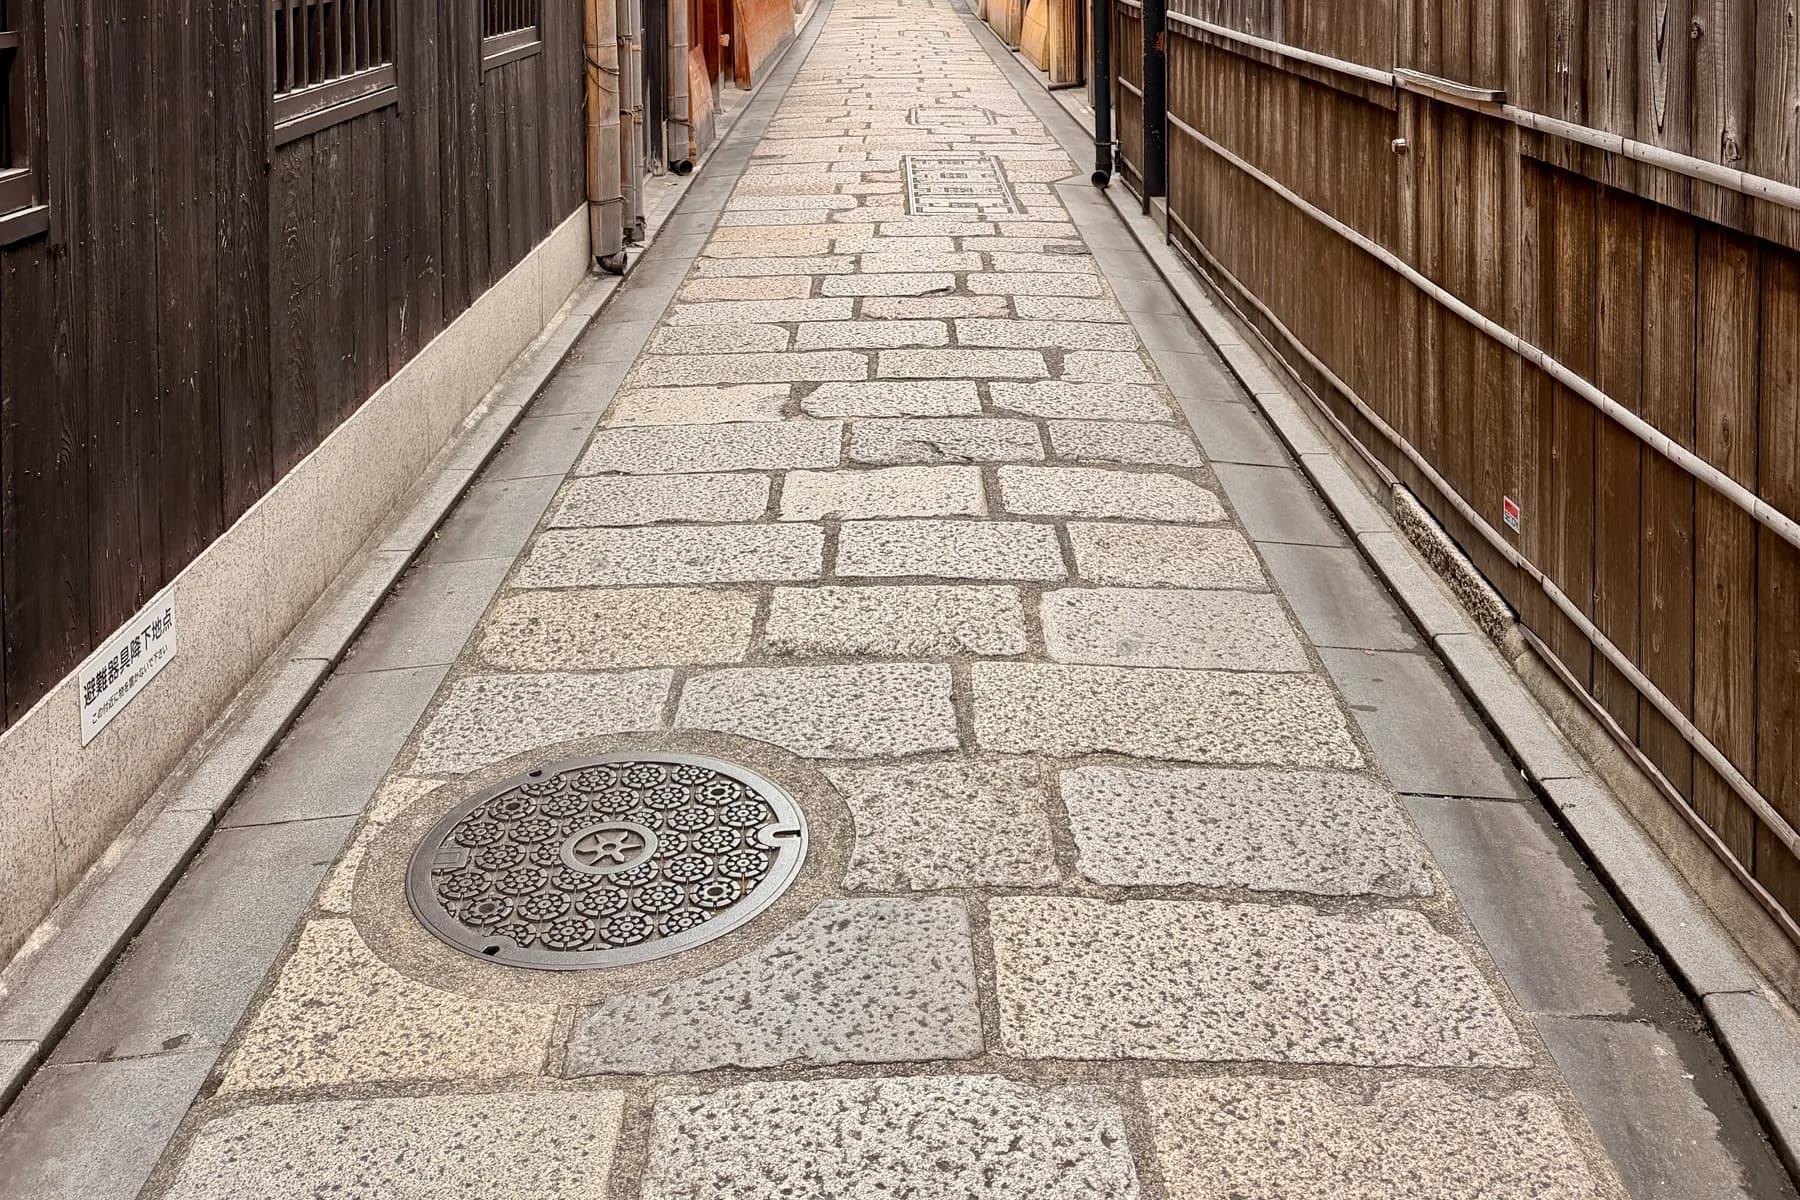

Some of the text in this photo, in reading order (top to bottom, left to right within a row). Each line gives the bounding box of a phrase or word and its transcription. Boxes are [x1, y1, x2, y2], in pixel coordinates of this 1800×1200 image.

[83, 607, 172, 709] 避難器具降下地点
